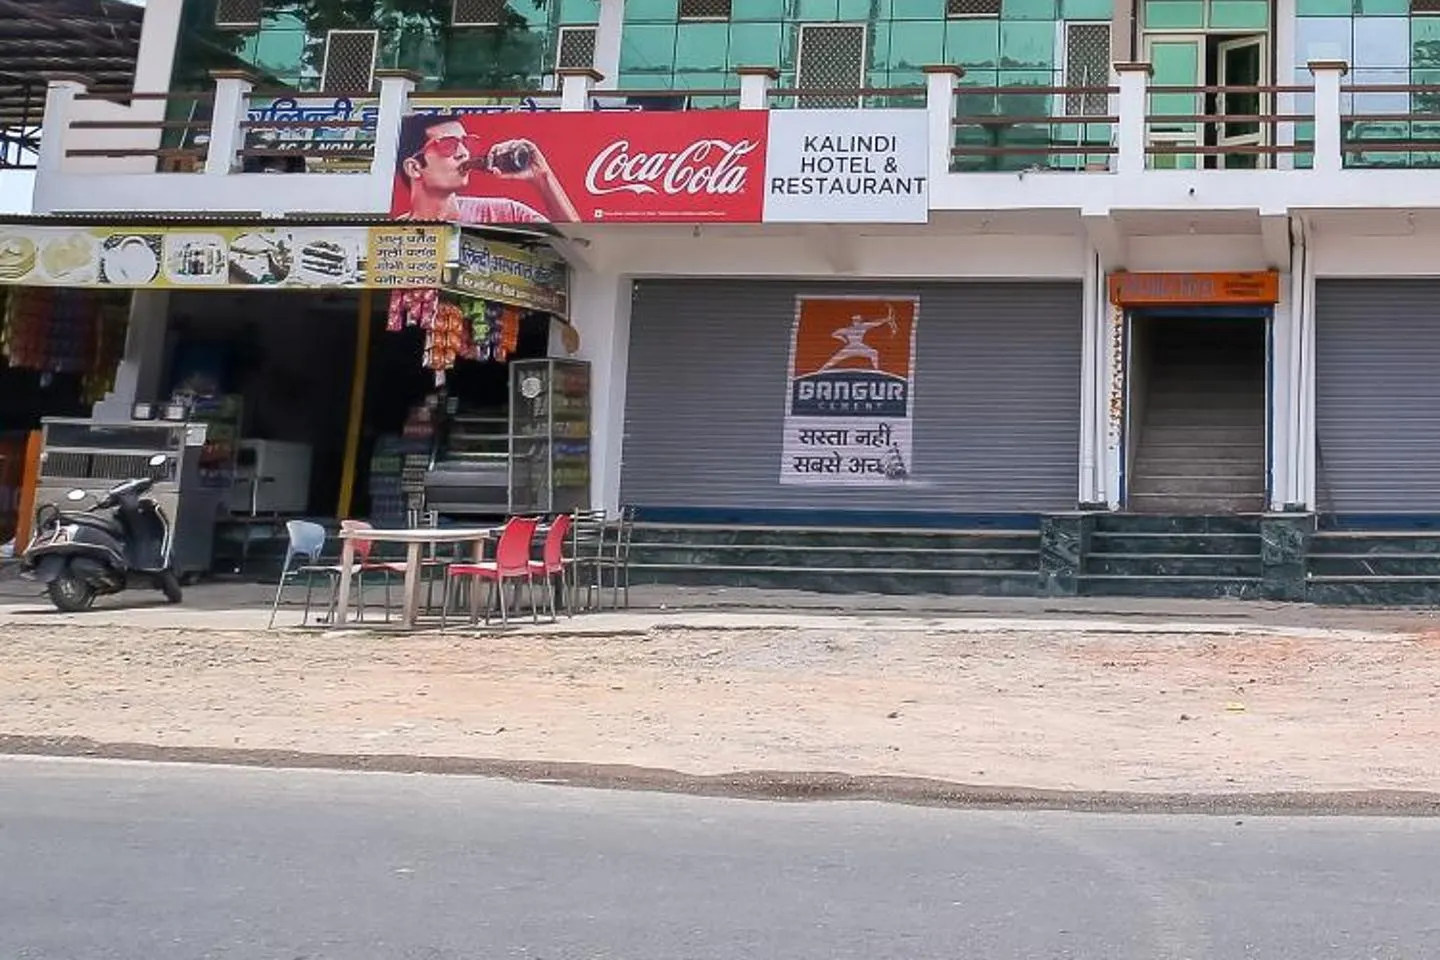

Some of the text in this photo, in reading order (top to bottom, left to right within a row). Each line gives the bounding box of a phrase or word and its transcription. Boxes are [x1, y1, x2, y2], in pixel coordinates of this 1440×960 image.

[803, 135, 897, 153] KALINDI
[585, 139, 761, 195] Coca-Cola
[800, 156, 898, 174] HOTEL &
[771, 177, 926, 194] RESTAURANT
[799, 381, 904, 400] BANGUR
[799, 429, 849, 446] सस्ता
[793, 451, 842, 473] सबसे
